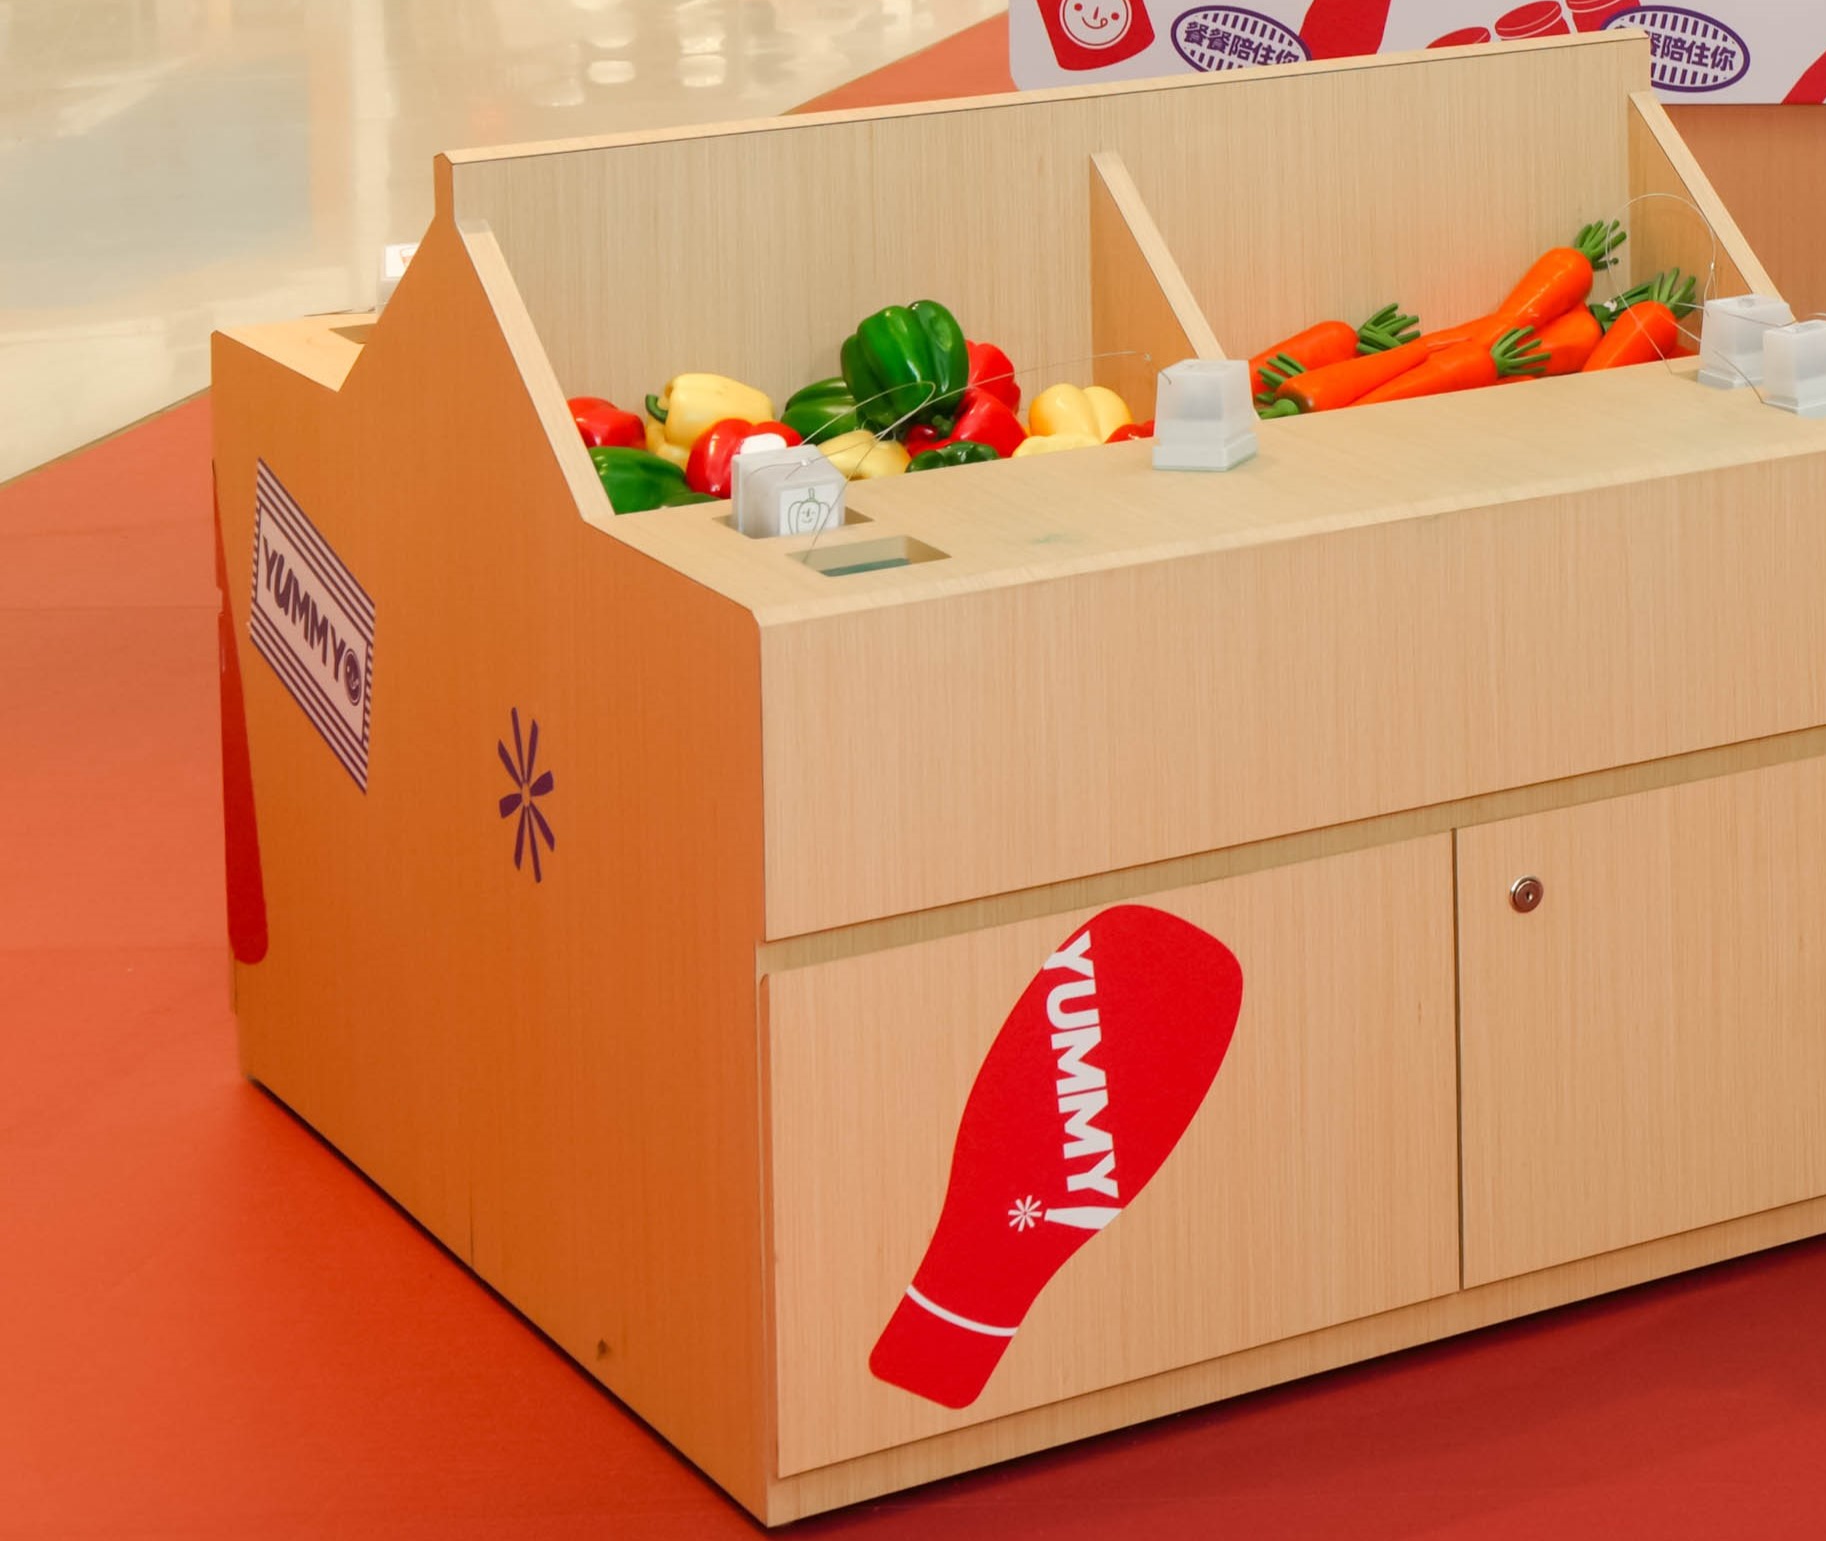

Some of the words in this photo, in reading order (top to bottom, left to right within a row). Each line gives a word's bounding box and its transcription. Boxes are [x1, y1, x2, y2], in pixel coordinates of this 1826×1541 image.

[1650, 31, 1736, 72] 陪住你
[263, 536, 347, 682] YUMMY
